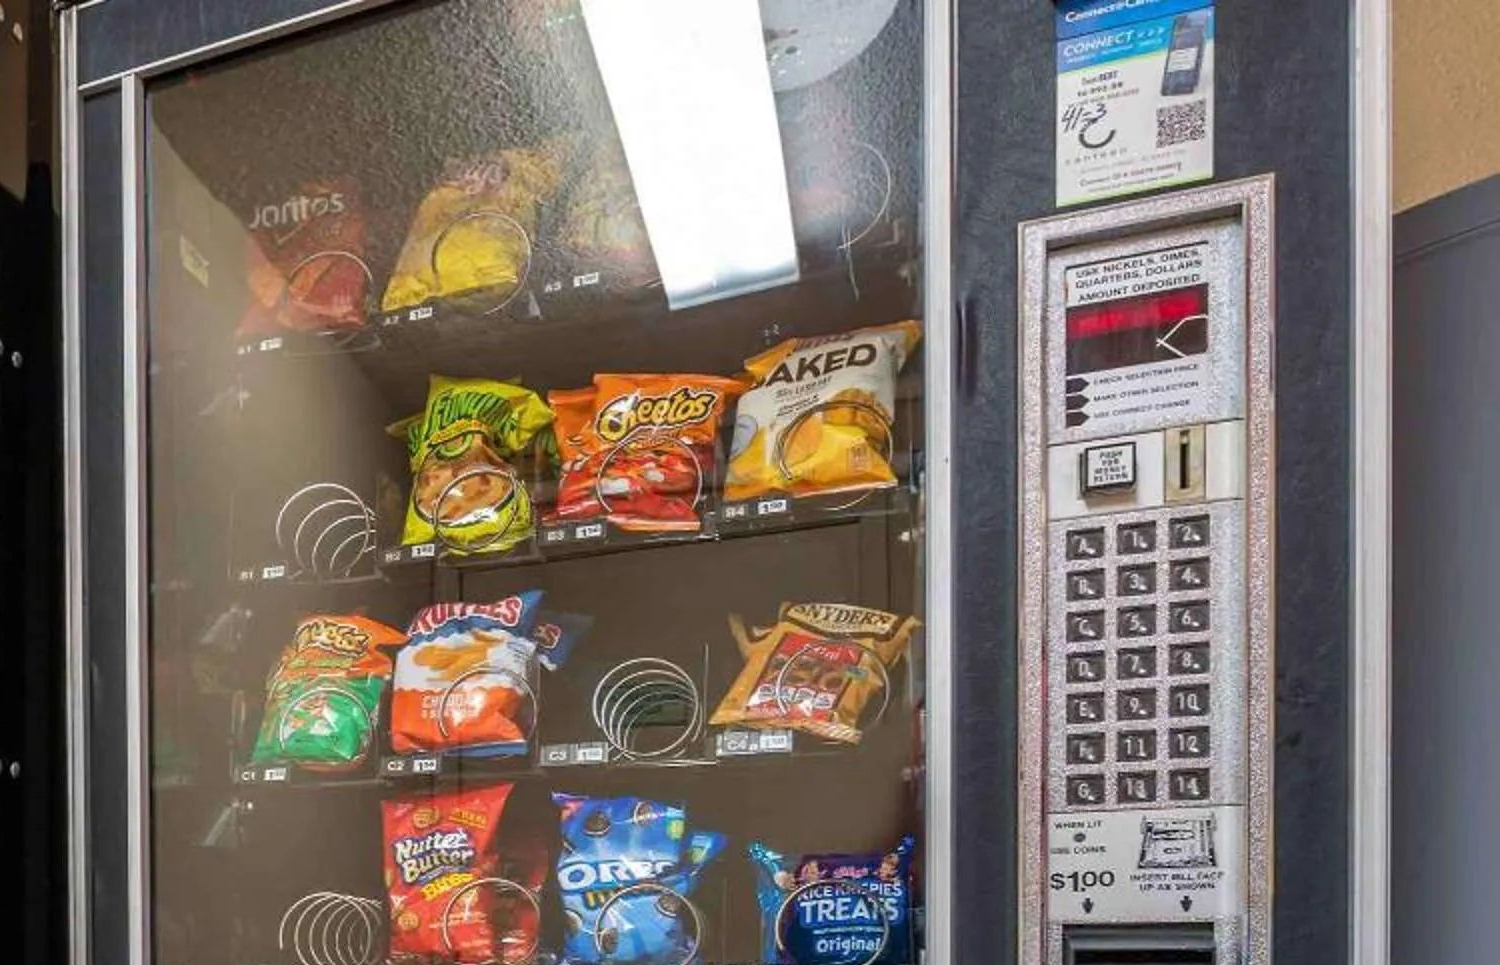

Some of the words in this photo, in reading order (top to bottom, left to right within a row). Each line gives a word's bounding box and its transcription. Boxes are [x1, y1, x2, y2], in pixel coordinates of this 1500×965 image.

[1064, 30, 1134, 56] CONNECT
[1079, 286, 1128, 302] AMOUNT
[1132, 273, 1200, 293] DEPOSITED
[599, 388, 715, 441] Cheetos
[1175, 691, 1198, 711] 10
[1124, 735, 1146, 757] 11
[1177, 733, 1199, 753] 12
[1055, 821, 1086, 830] WHEN
[395, 828, 469, 863] Nutter
[402, 848, 474, 883] Butter
[1130, 872, 1168, 882] INSERT
[1050, 870, 1116, 893] $1.00
[1139, 882, 1155, 893] UP
[800, 897, 899, 924] TREATS
[817, 935, 881, 955] Original
